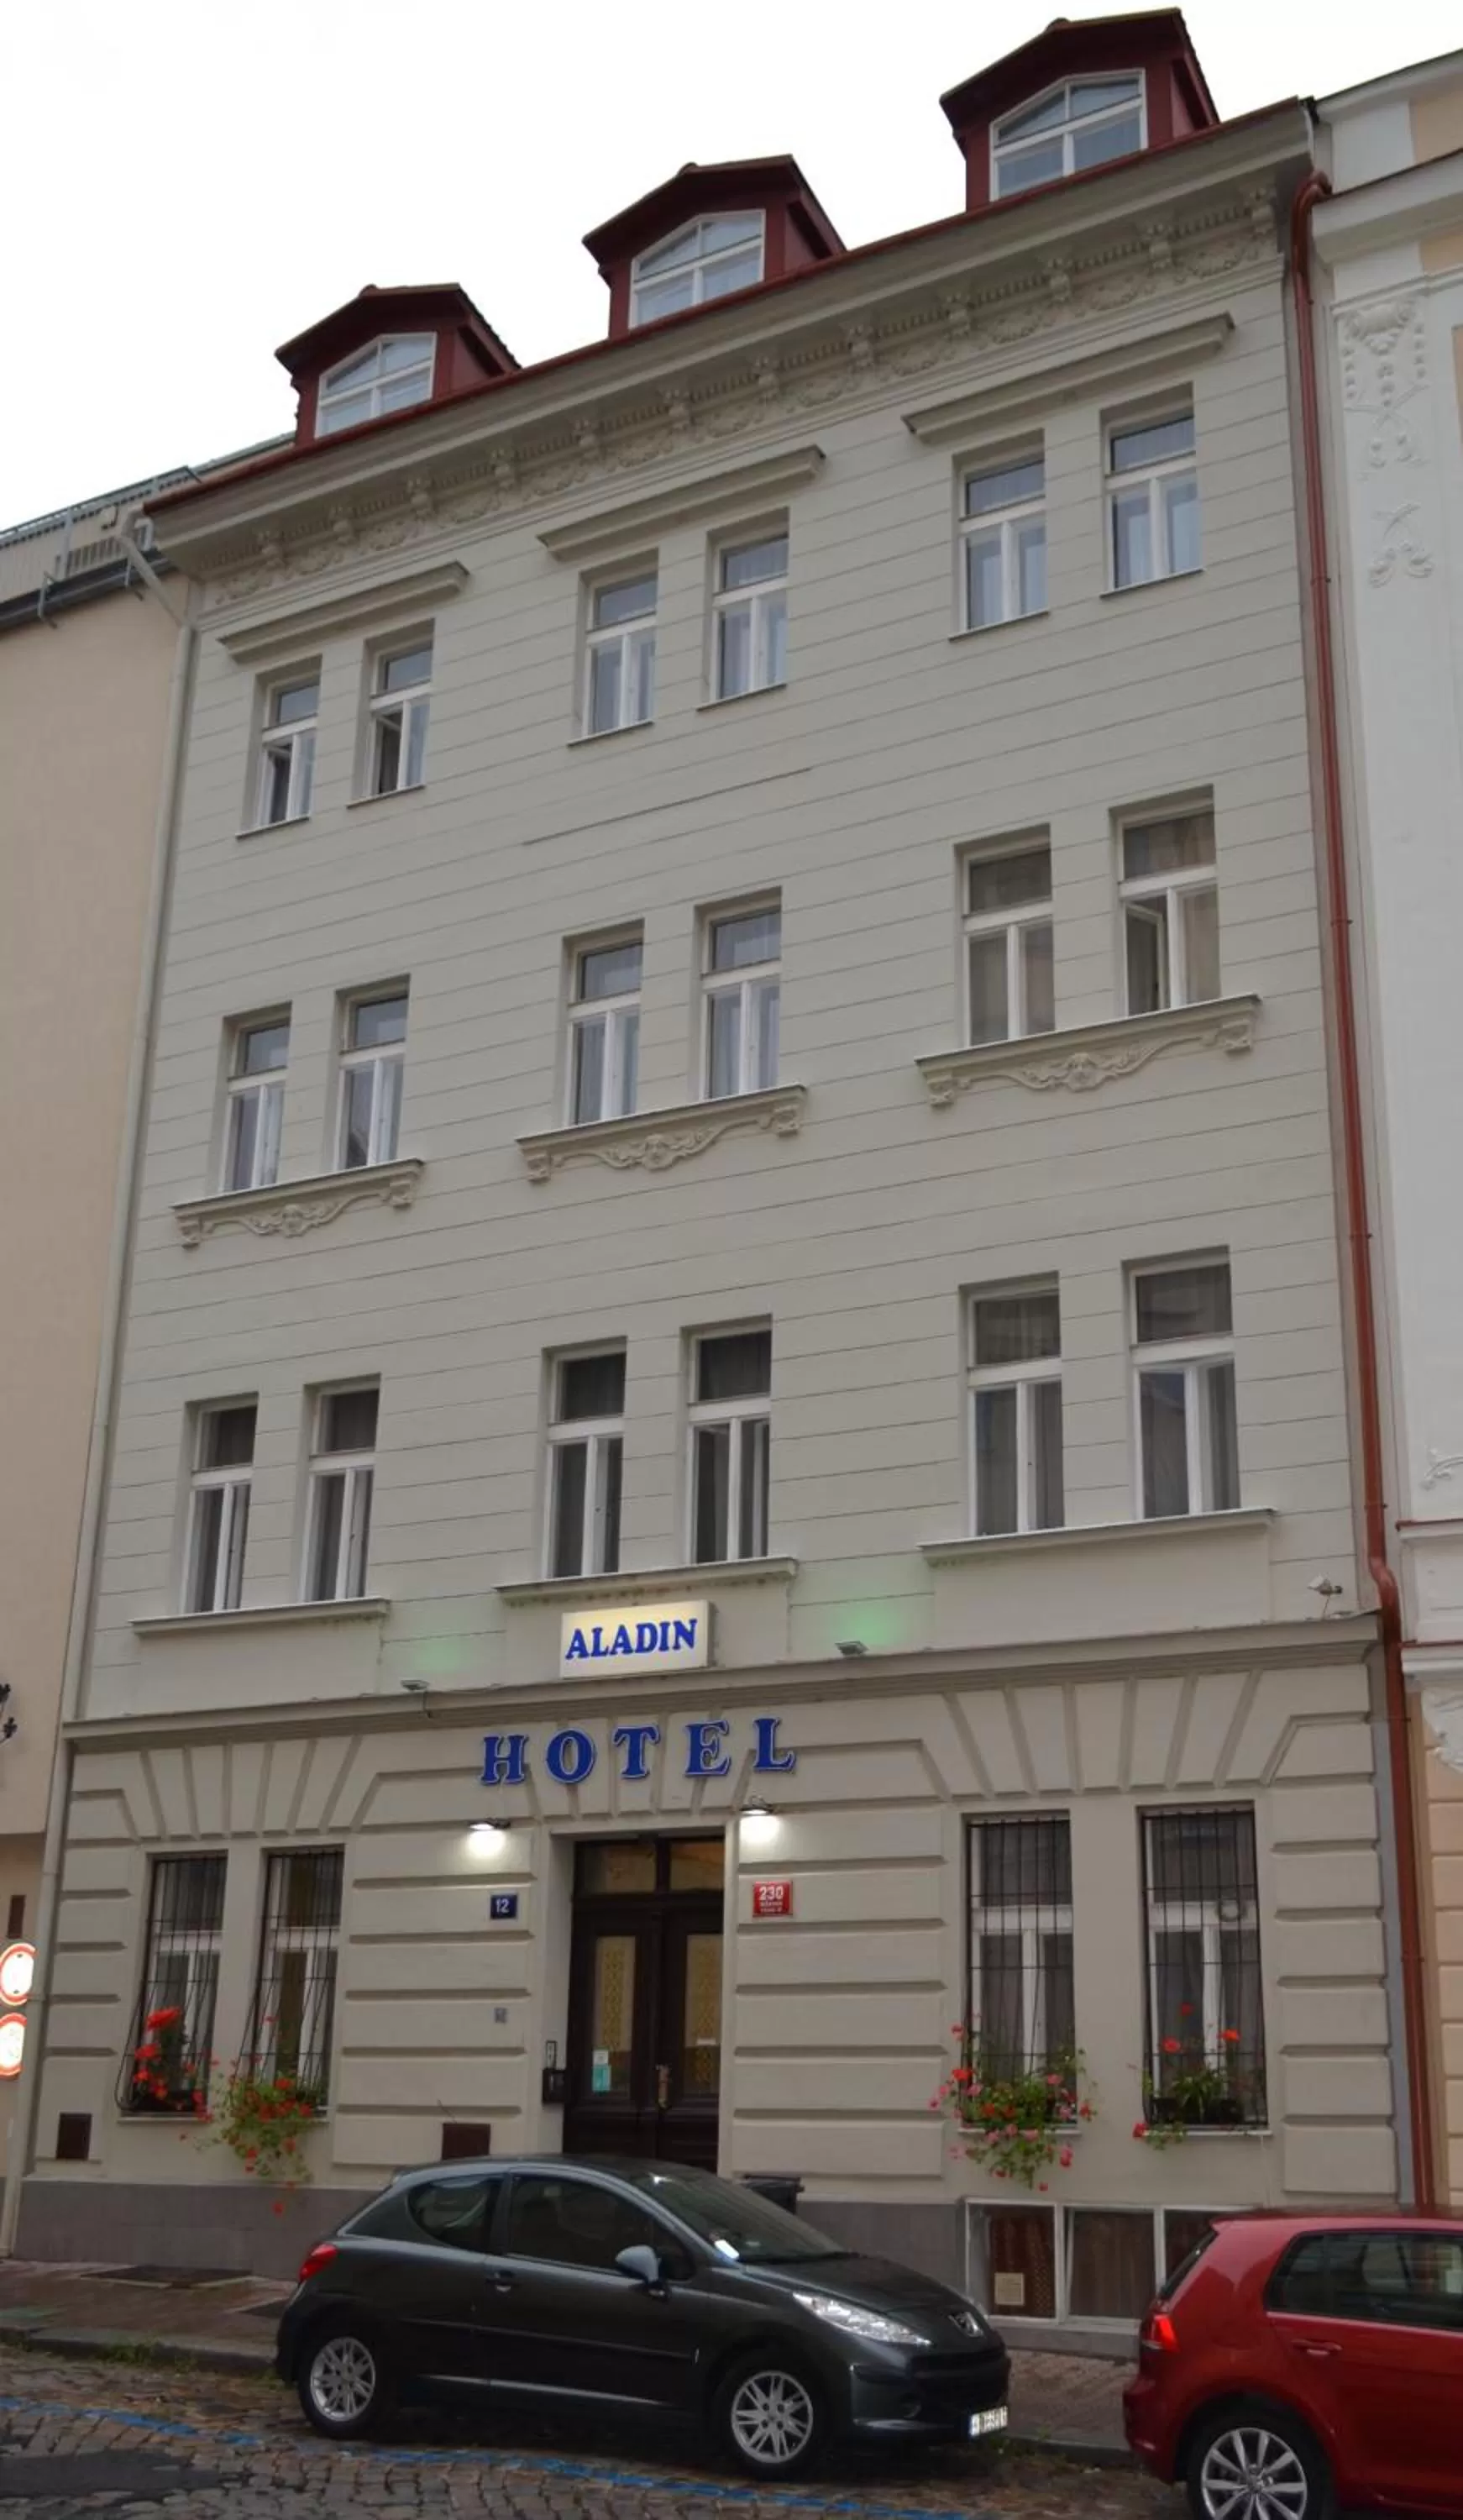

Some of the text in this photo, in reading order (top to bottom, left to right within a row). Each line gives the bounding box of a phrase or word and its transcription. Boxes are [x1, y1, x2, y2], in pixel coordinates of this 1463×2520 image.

[565, 1618, 697, 1660] ALADIN
[480, 1716, 795, 1786] HOTEL
[496, 1898, 510, 1913] 12
[759, 1885, 784, 1900] 230
